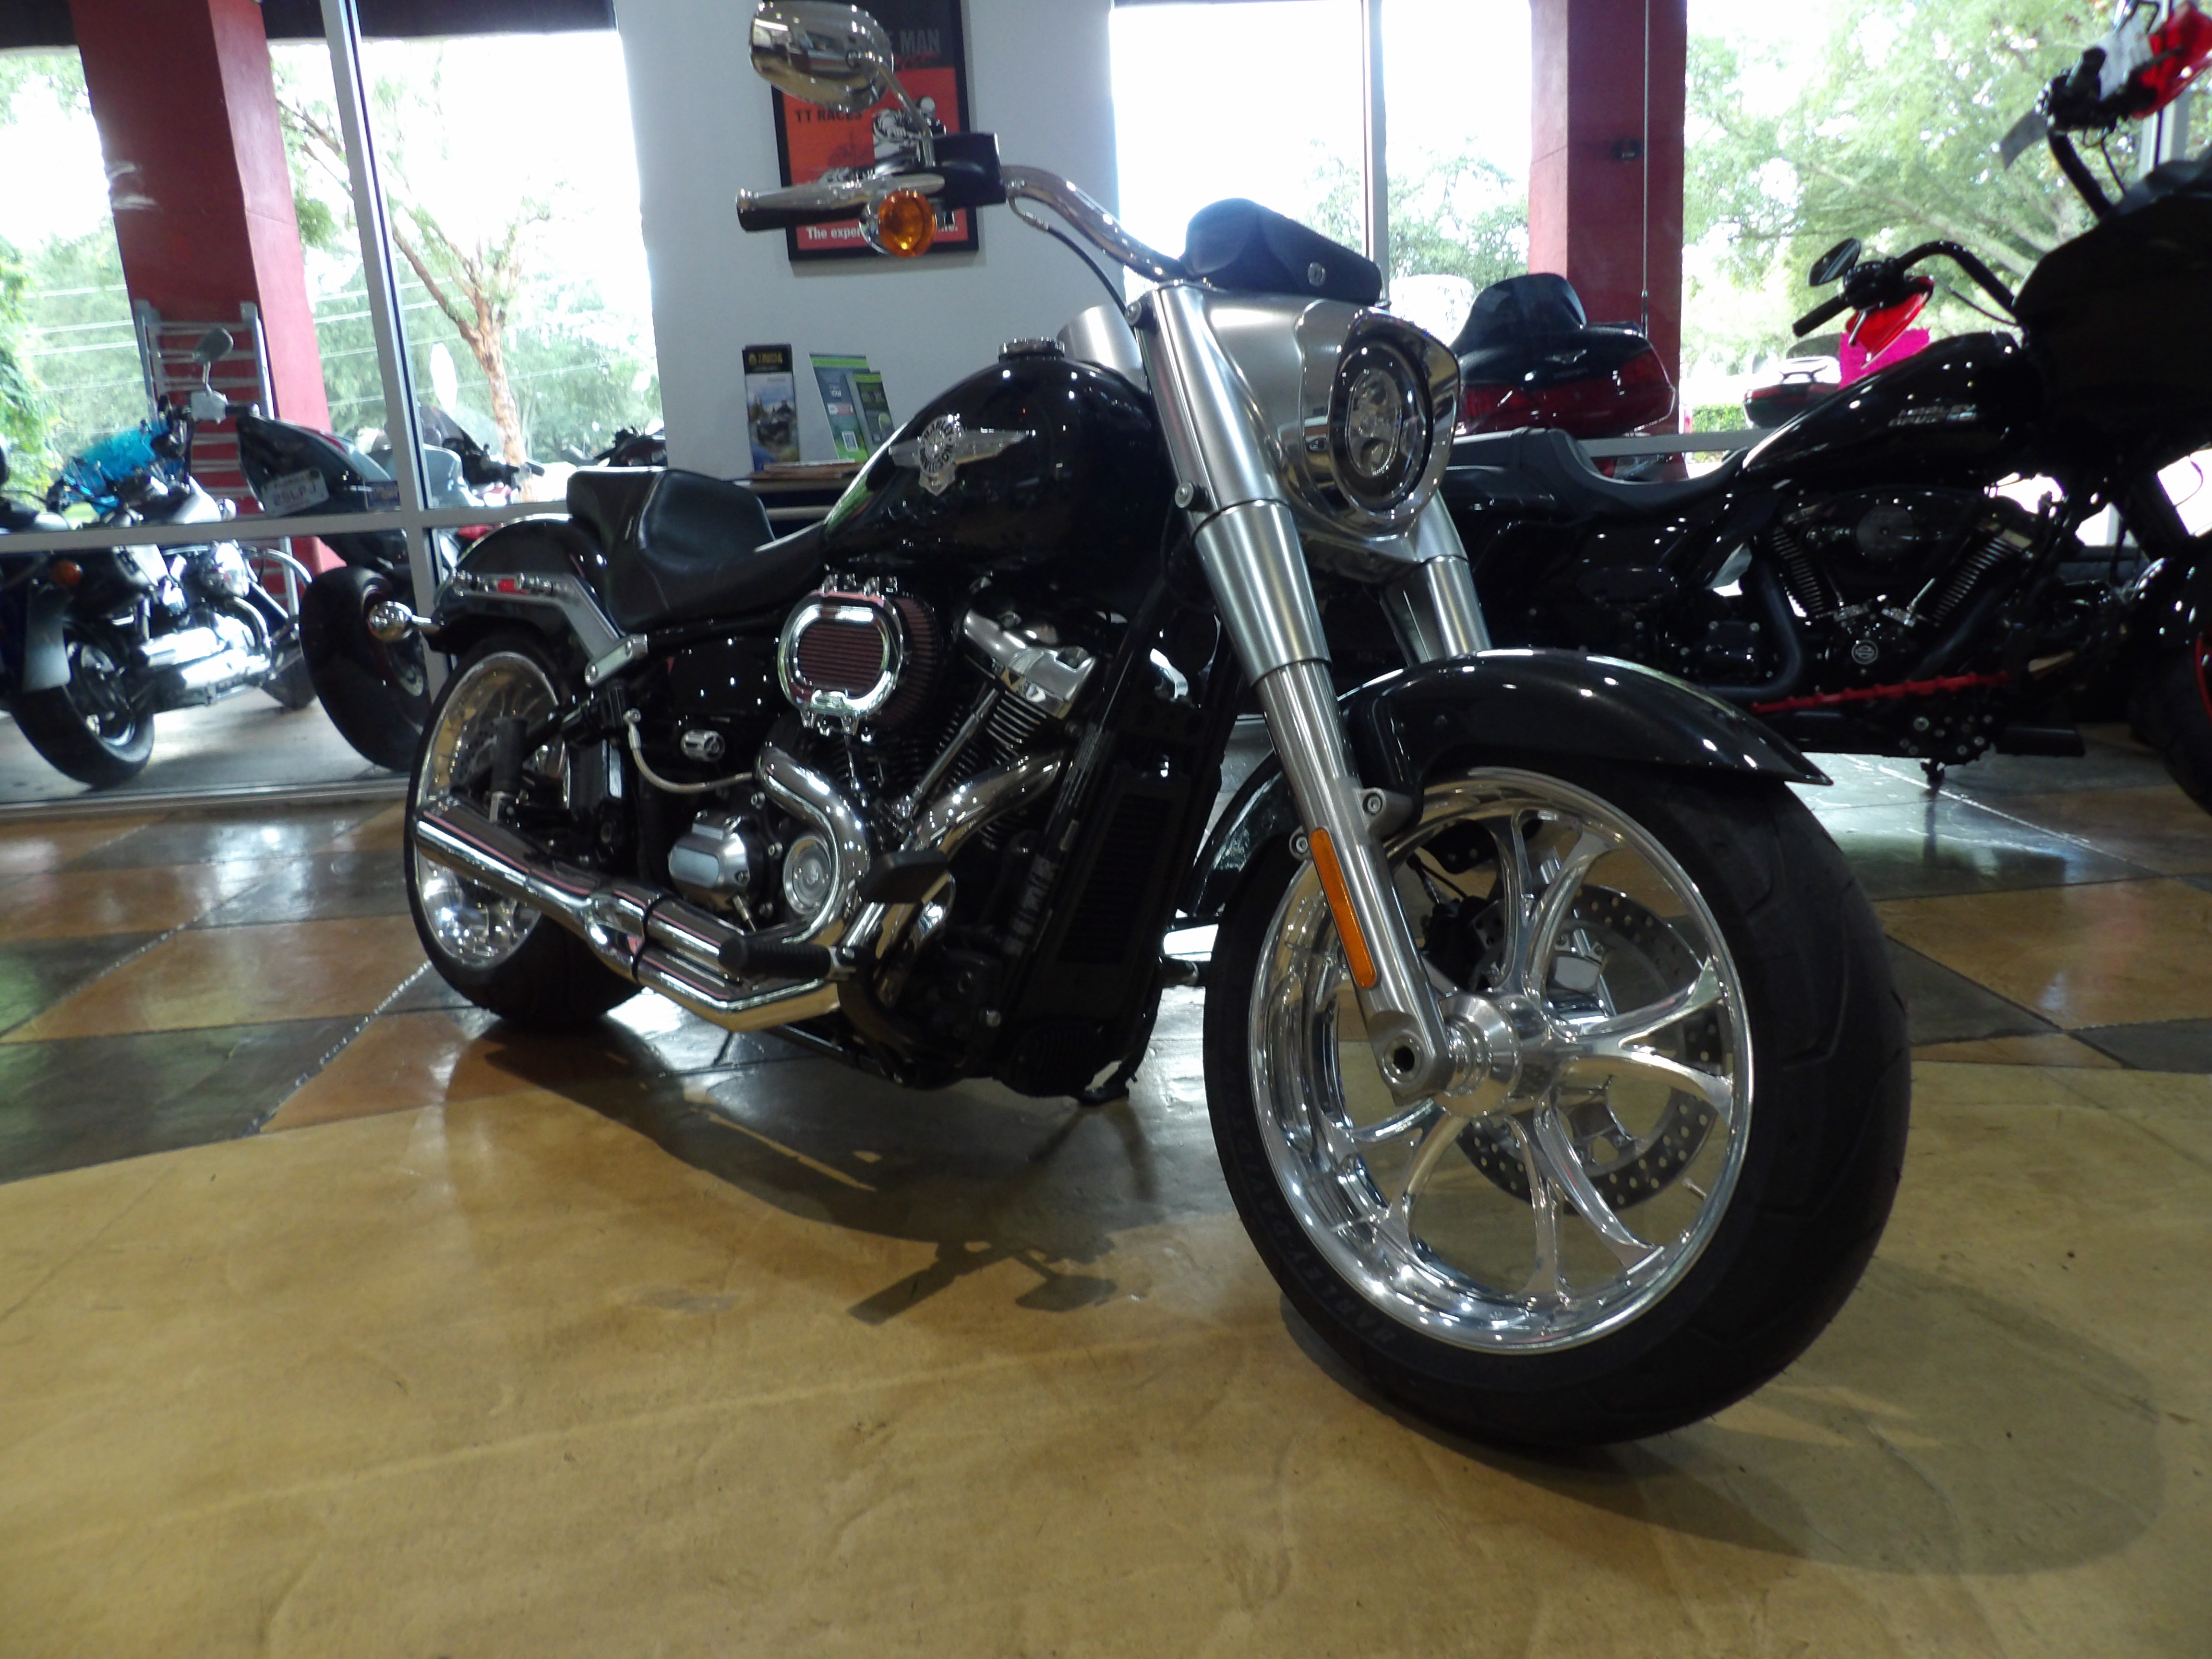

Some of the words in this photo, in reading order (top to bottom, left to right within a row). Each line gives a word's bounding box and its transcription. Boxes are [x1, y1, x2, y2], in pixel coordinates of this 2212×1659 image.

[900, 28, 941, 55] MAN
[795, 110, 811, 122] TT
[806, 226, 827, 240] The
